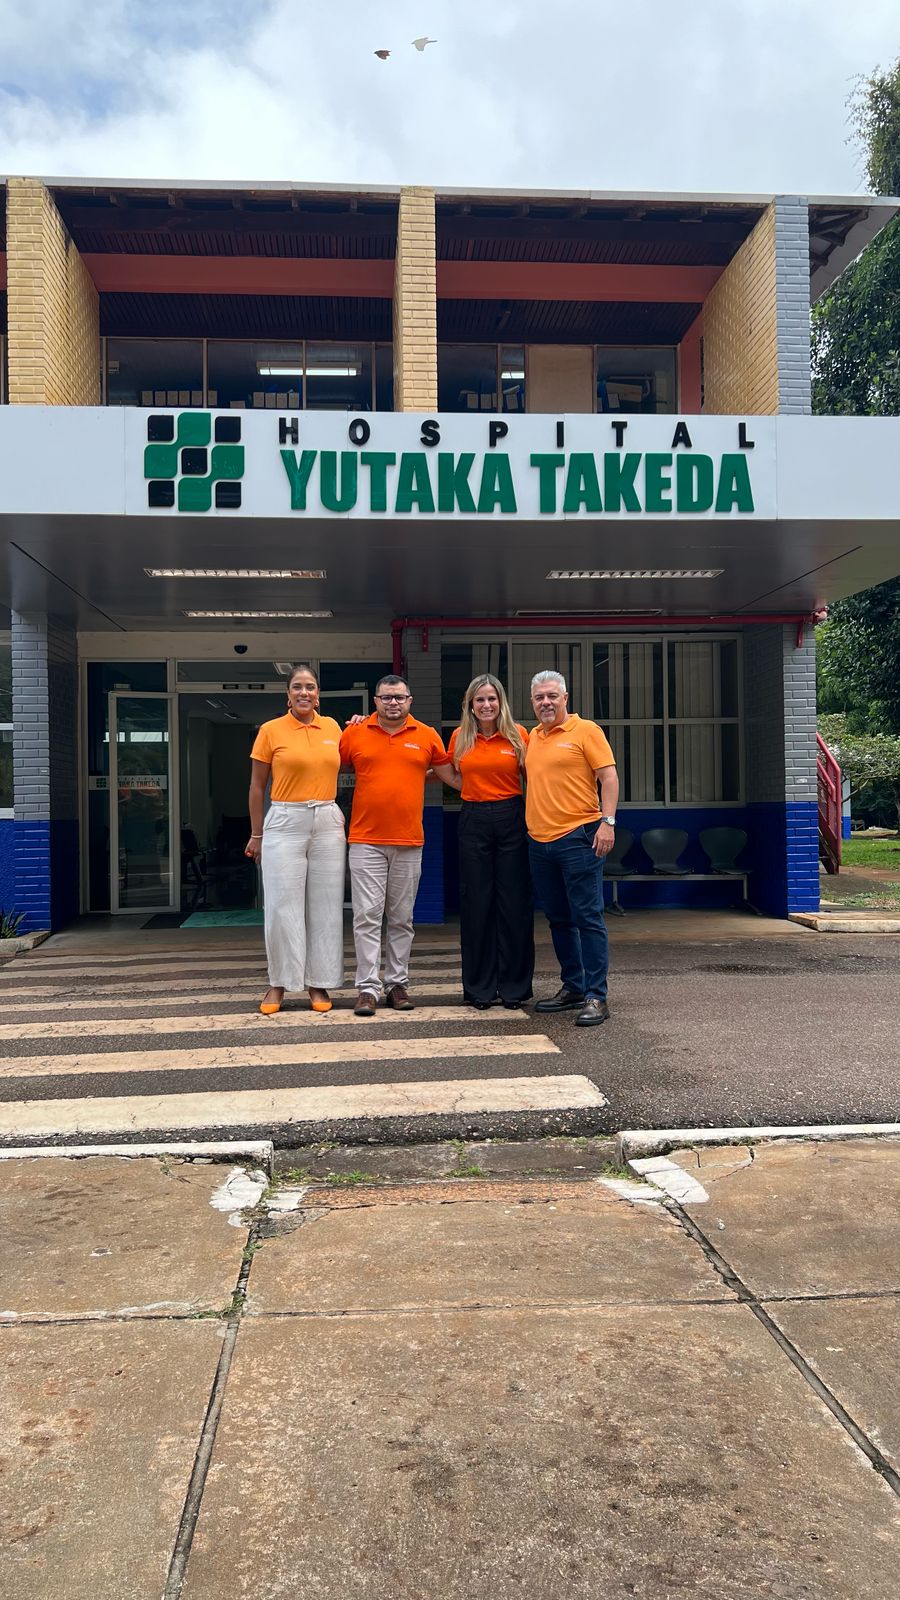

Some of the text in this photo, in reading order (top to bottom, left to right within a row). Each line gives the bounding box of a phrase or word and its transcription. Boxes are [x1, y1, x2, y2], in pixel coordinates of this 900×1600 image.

[279, 416, 755, 449] HOSPITAL
[280, 449, 755, 514] YUTAKA TAKEDA
